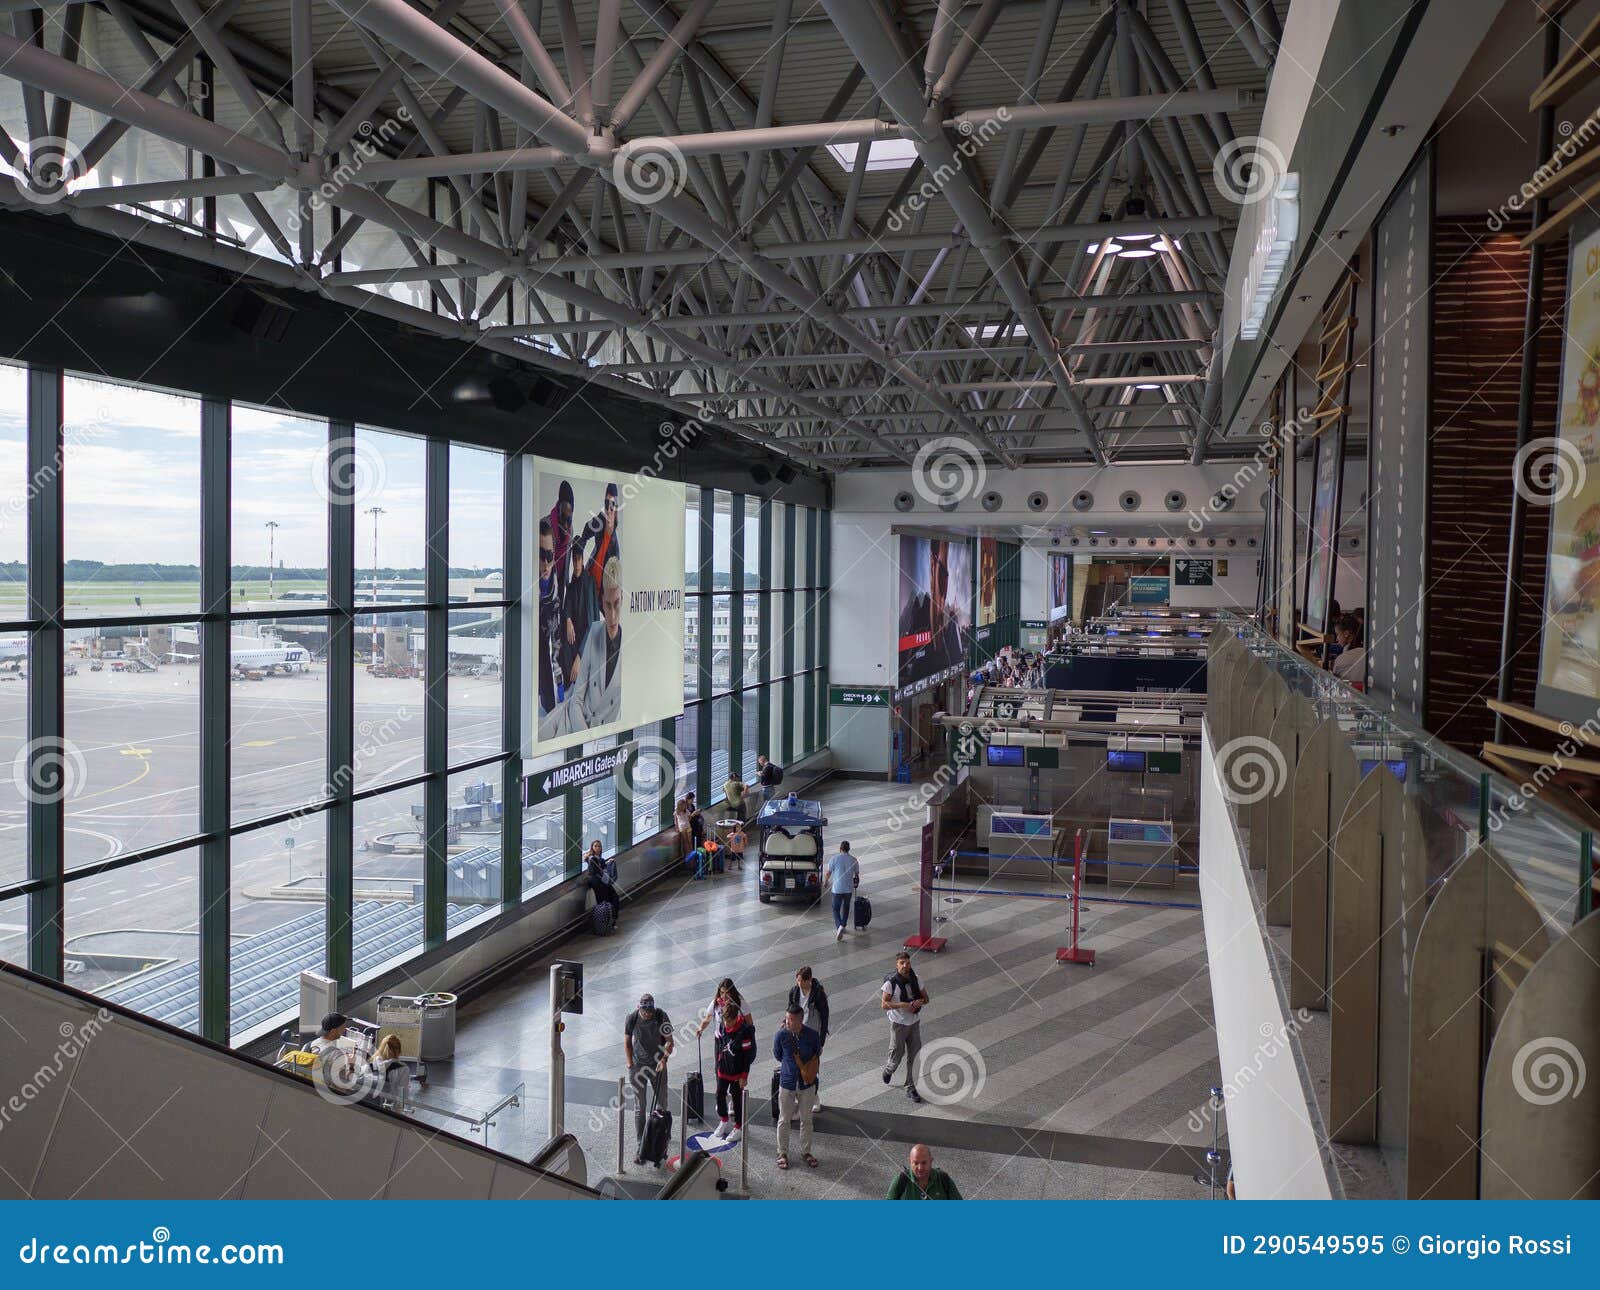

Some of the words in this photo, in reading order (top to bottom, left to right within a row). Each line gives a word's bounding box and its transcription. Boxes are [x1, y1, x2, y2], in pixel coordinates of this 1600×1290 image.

[630, 591, 655, 612] ANTONY
[658, 589, 680, 611] MORATO
[285, 651, 303, 661] LOT
[552, 759, 593, 788] IMBARCHI
[595, 754, 616, 774] Gates
